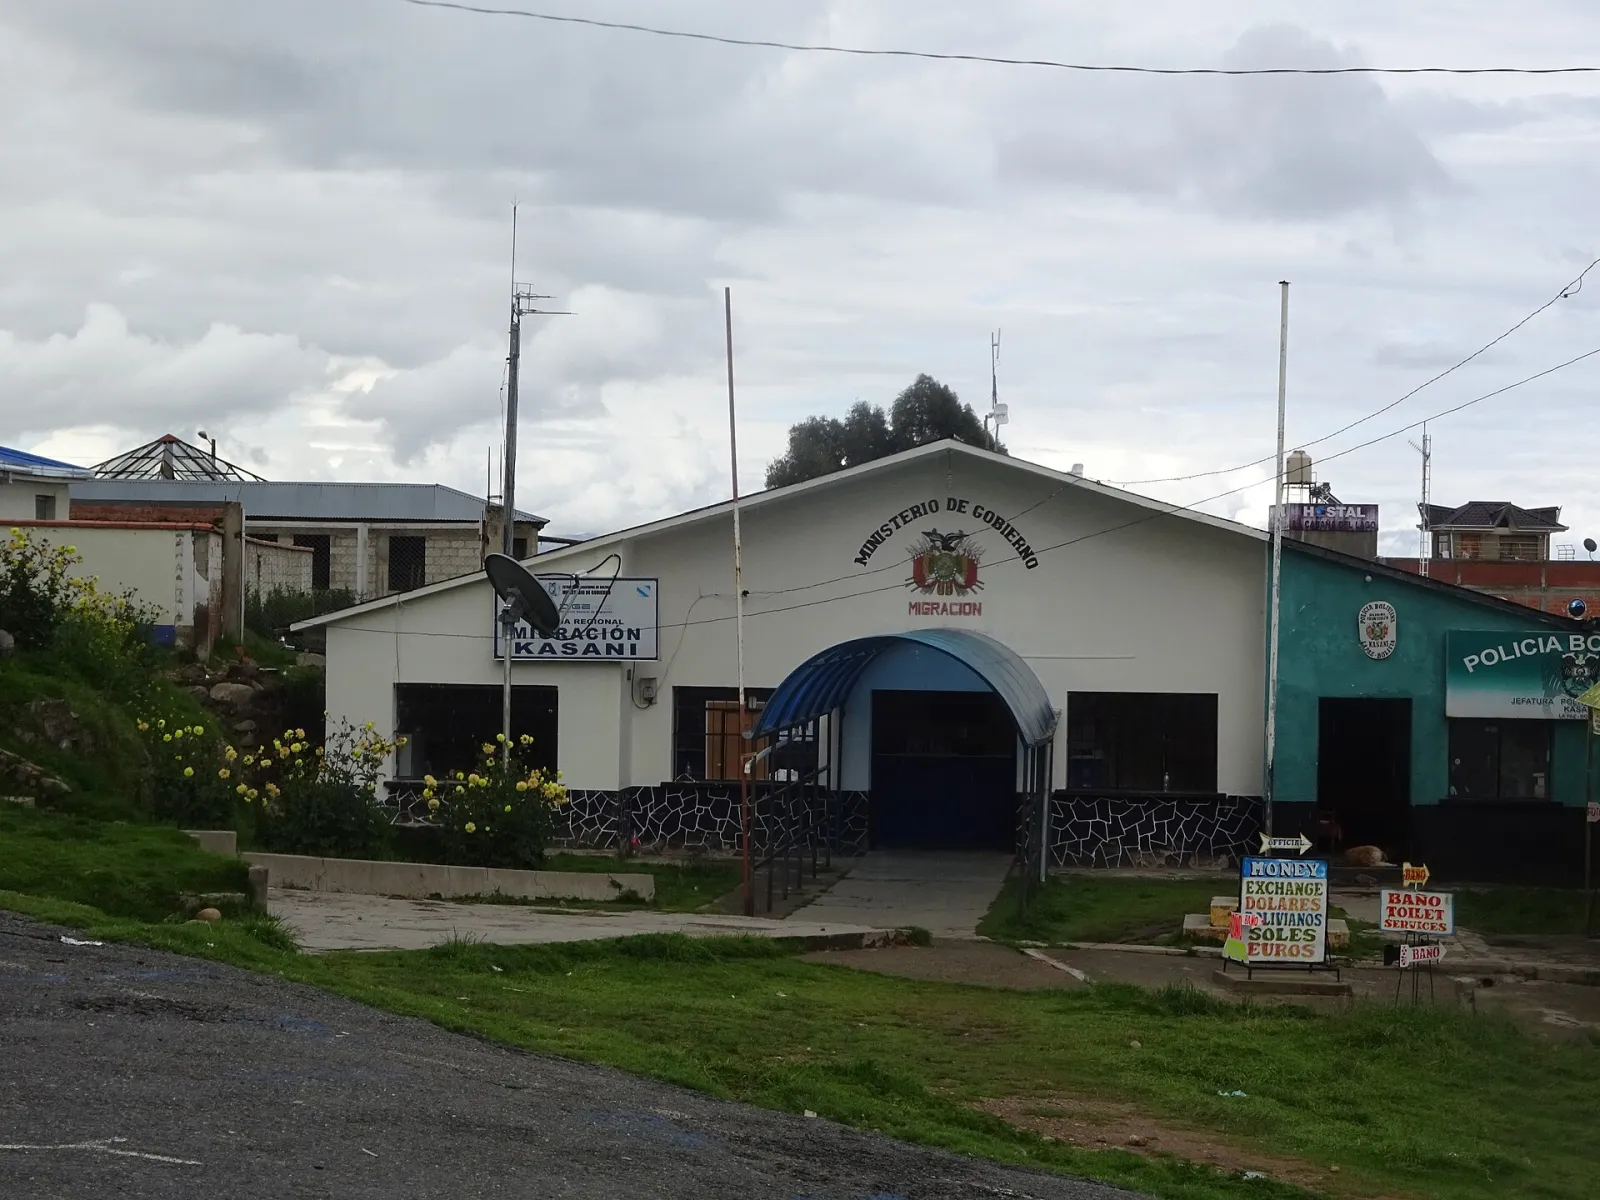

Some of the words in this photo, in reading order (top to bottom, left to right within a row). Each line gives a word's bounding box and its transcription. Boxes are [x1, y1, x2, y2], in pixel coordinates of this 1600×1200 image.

[853, 499, 940, 567] MINISTERIO
[946, 497, 970, 514] DE
[972, 505, 1039, 570] GOBIERNO
[908, 601, 982, 617] MIGRACION
[514, 642, 637, 656] KASANI
[1463, 636, 1563, 673] POLICIA
[1510, 698, 1554, 706] JEFATURA
[1268, 839, 1305, 847] OFFICIAL
[1250, 860, 1320, 877] MONEY
[1245, 880, 1324, 897] EXCHANGE
[1245, 896, 1322, 912] DOLARES
[1387, 892, 1442, 907] BAÑO
[1386, 905, 1445, 921] TOILET
[1384, 918, 1447, 932] SERVICES
[1248, 928, 1317, 942] SOLES
[1247, 942, 1316, 958] EUROS
